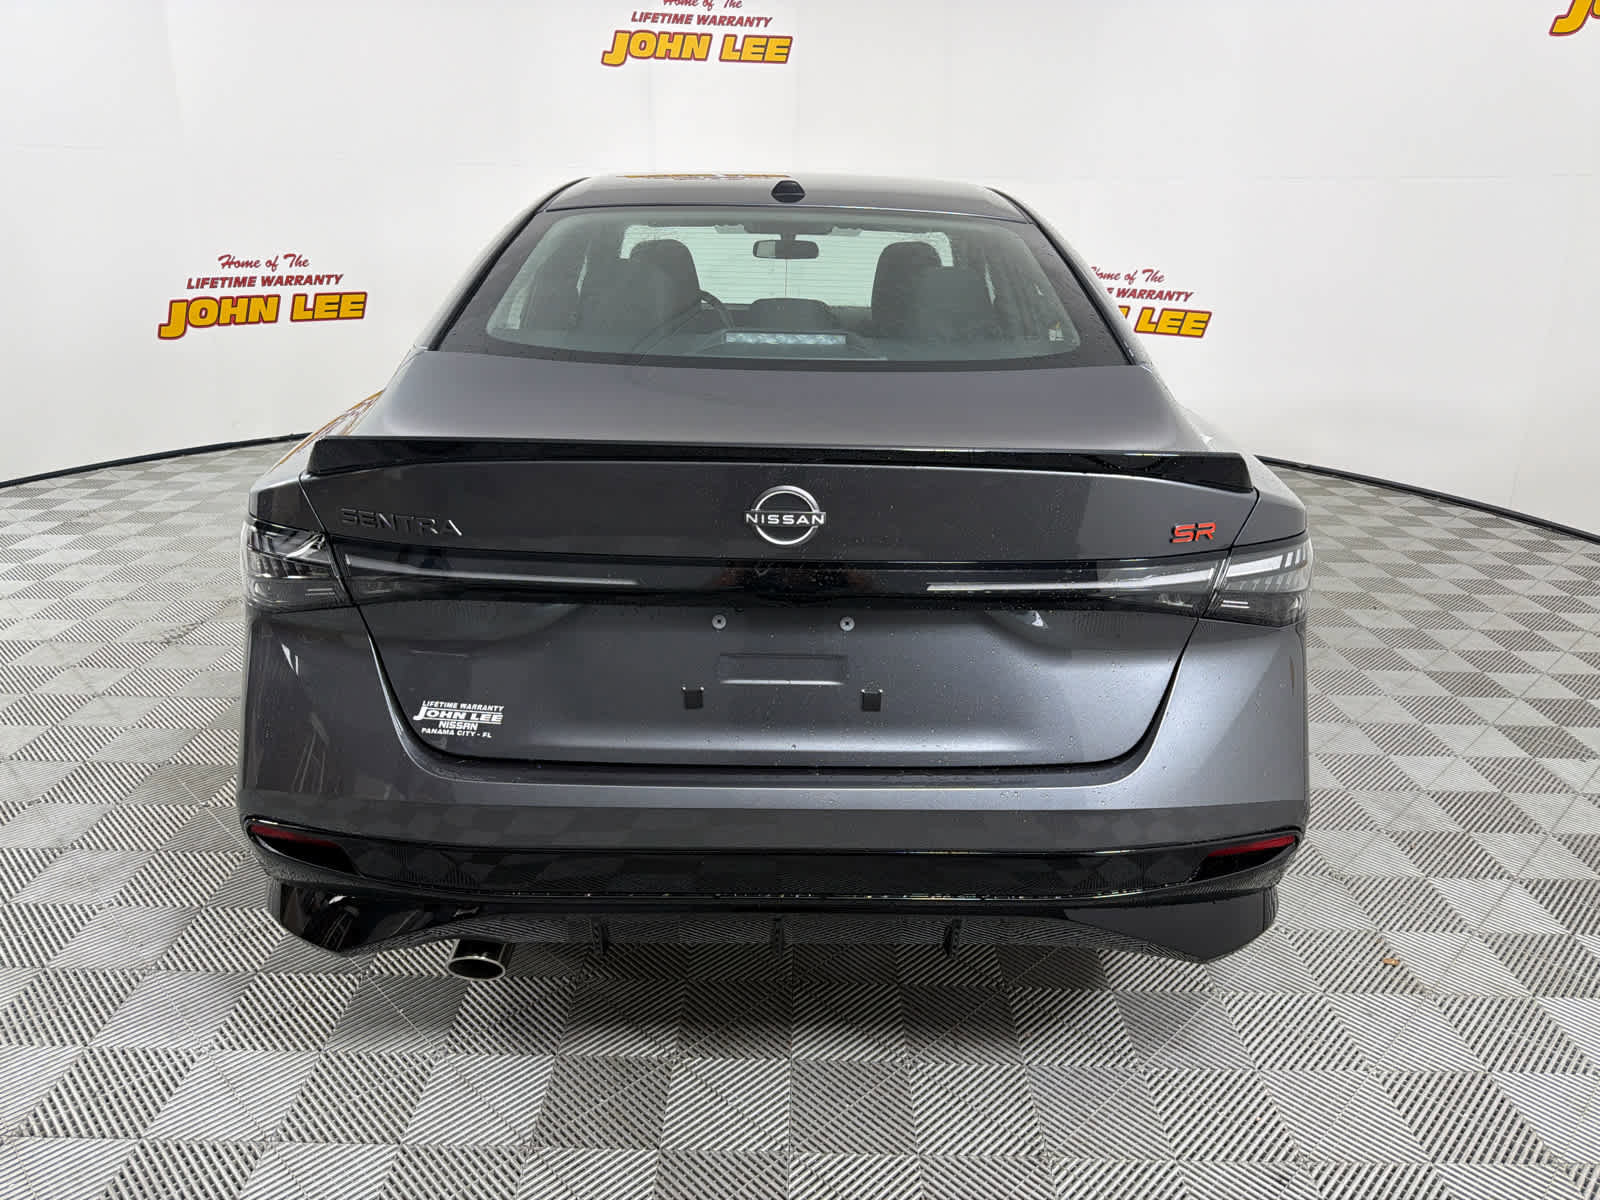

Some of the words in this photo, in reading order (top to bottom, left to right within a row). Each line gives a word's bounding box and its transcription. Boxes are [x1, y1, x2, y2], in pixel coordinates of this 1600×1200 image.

[631, 11, 694, 25] LIFETIME
[696, 14, 773, 28] WARRANTY
[601, 30, 713, 67] JOHN
[719, 34, 793, 64] LEE
[218, 254, 261, 269] Home
[265, 255, 279, 272] of
[283, 253, 310, 268] The
[186, 276, 257, 289] LIFETIME
[261, 273, 344, 287] WARRANTY
[1124, 269, 1138, 285] of
[1142, 268, 1165, 283] The
[1116, 287, 1194, 302] WARRANTY
[158, 294, 281, 340] JOHN
[290, 291, 368, 322] LEE
[1134, 306, 1212, 338] LEE
[337, 506, 463, 536] SENTRA
[745, 512, 825, 525] NISSAN
[1171, 522, 1217, 543] SR
[413, 706, 466, 720] JOHN
[470, 712, 504, 722] LEE
[422, 700, 458, 709] LIFETIME
[460, 703, 504, 712] WARRANTY
[421, 728, 455, 736] PANAMA
[438, 720, 478, 731] NISSAN
